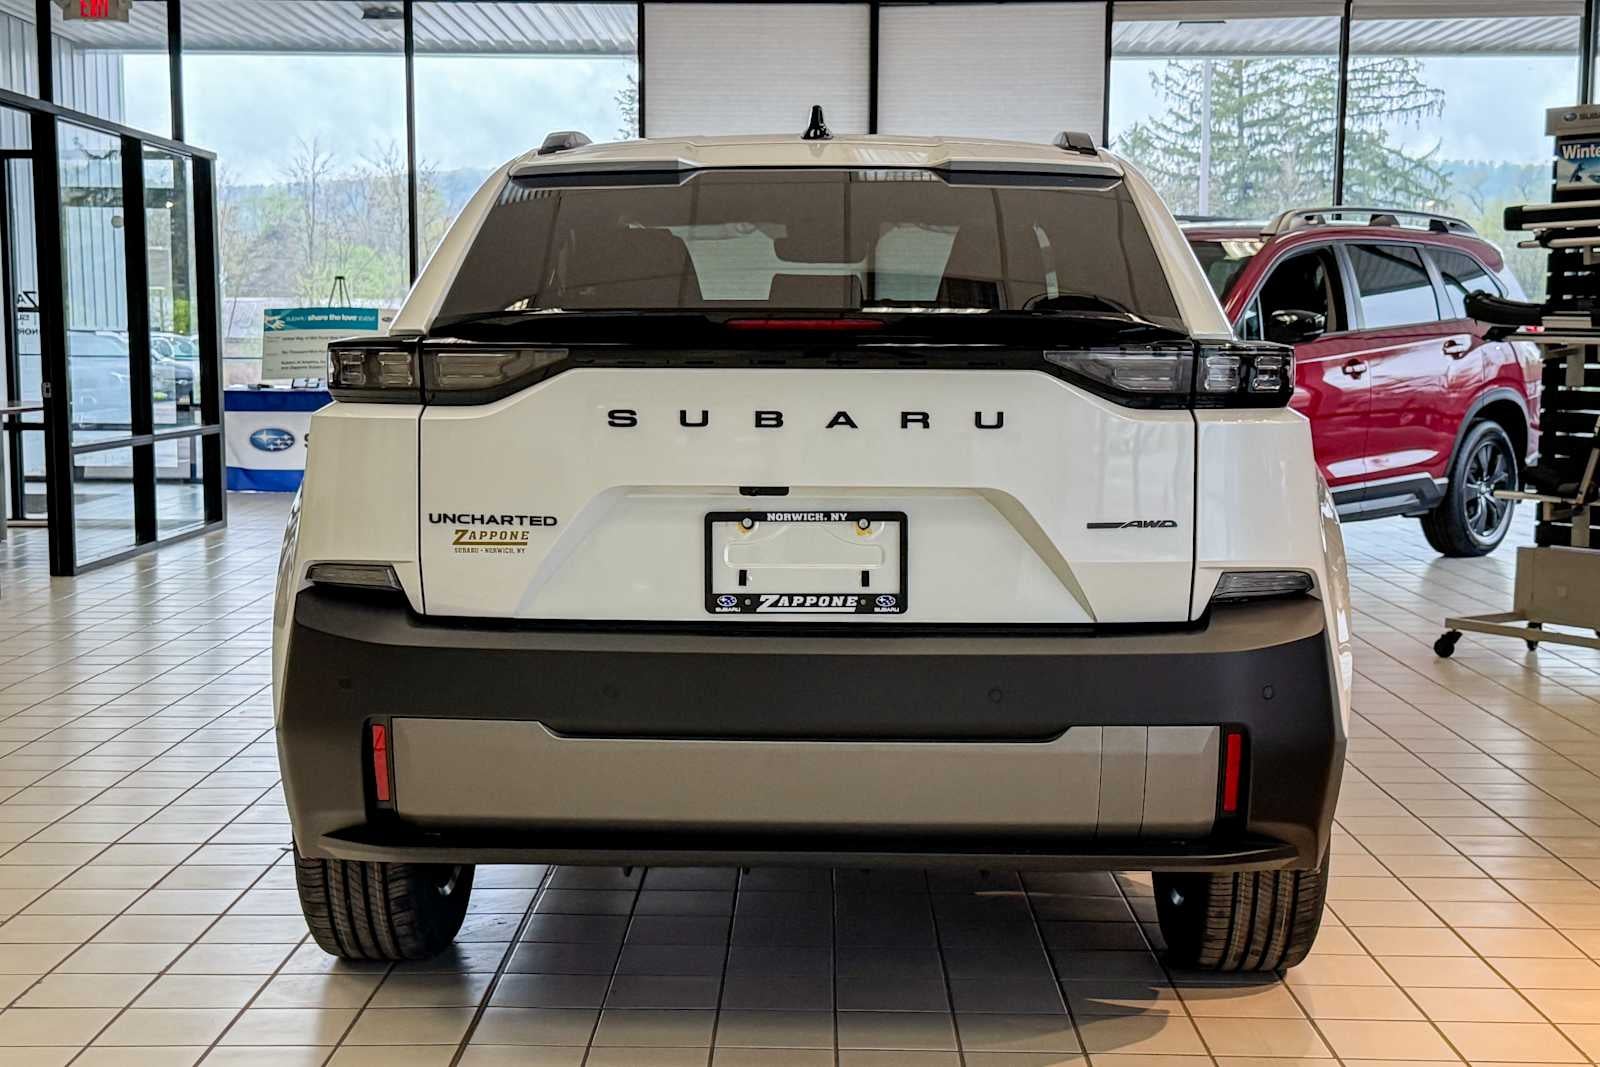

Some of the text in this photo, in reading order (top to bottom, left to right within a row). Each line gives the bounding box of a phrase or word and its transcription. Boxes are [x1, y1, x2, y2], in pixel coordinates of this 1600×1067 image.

[307, 313, 328, 321] share
[329, 313, 341, 321] the
[341, 313, 357, 321] love
[607, 408, 1005, 429] SUBARU
[429, 513, 558, 527] UNCHARTED
[830, 512, 848, 521] NY
[1121, 520, 1178, 529] AWD
[452, 529, 530, 546] ZAPPONE
[756, 595, 859, 613] ZAPPONE
